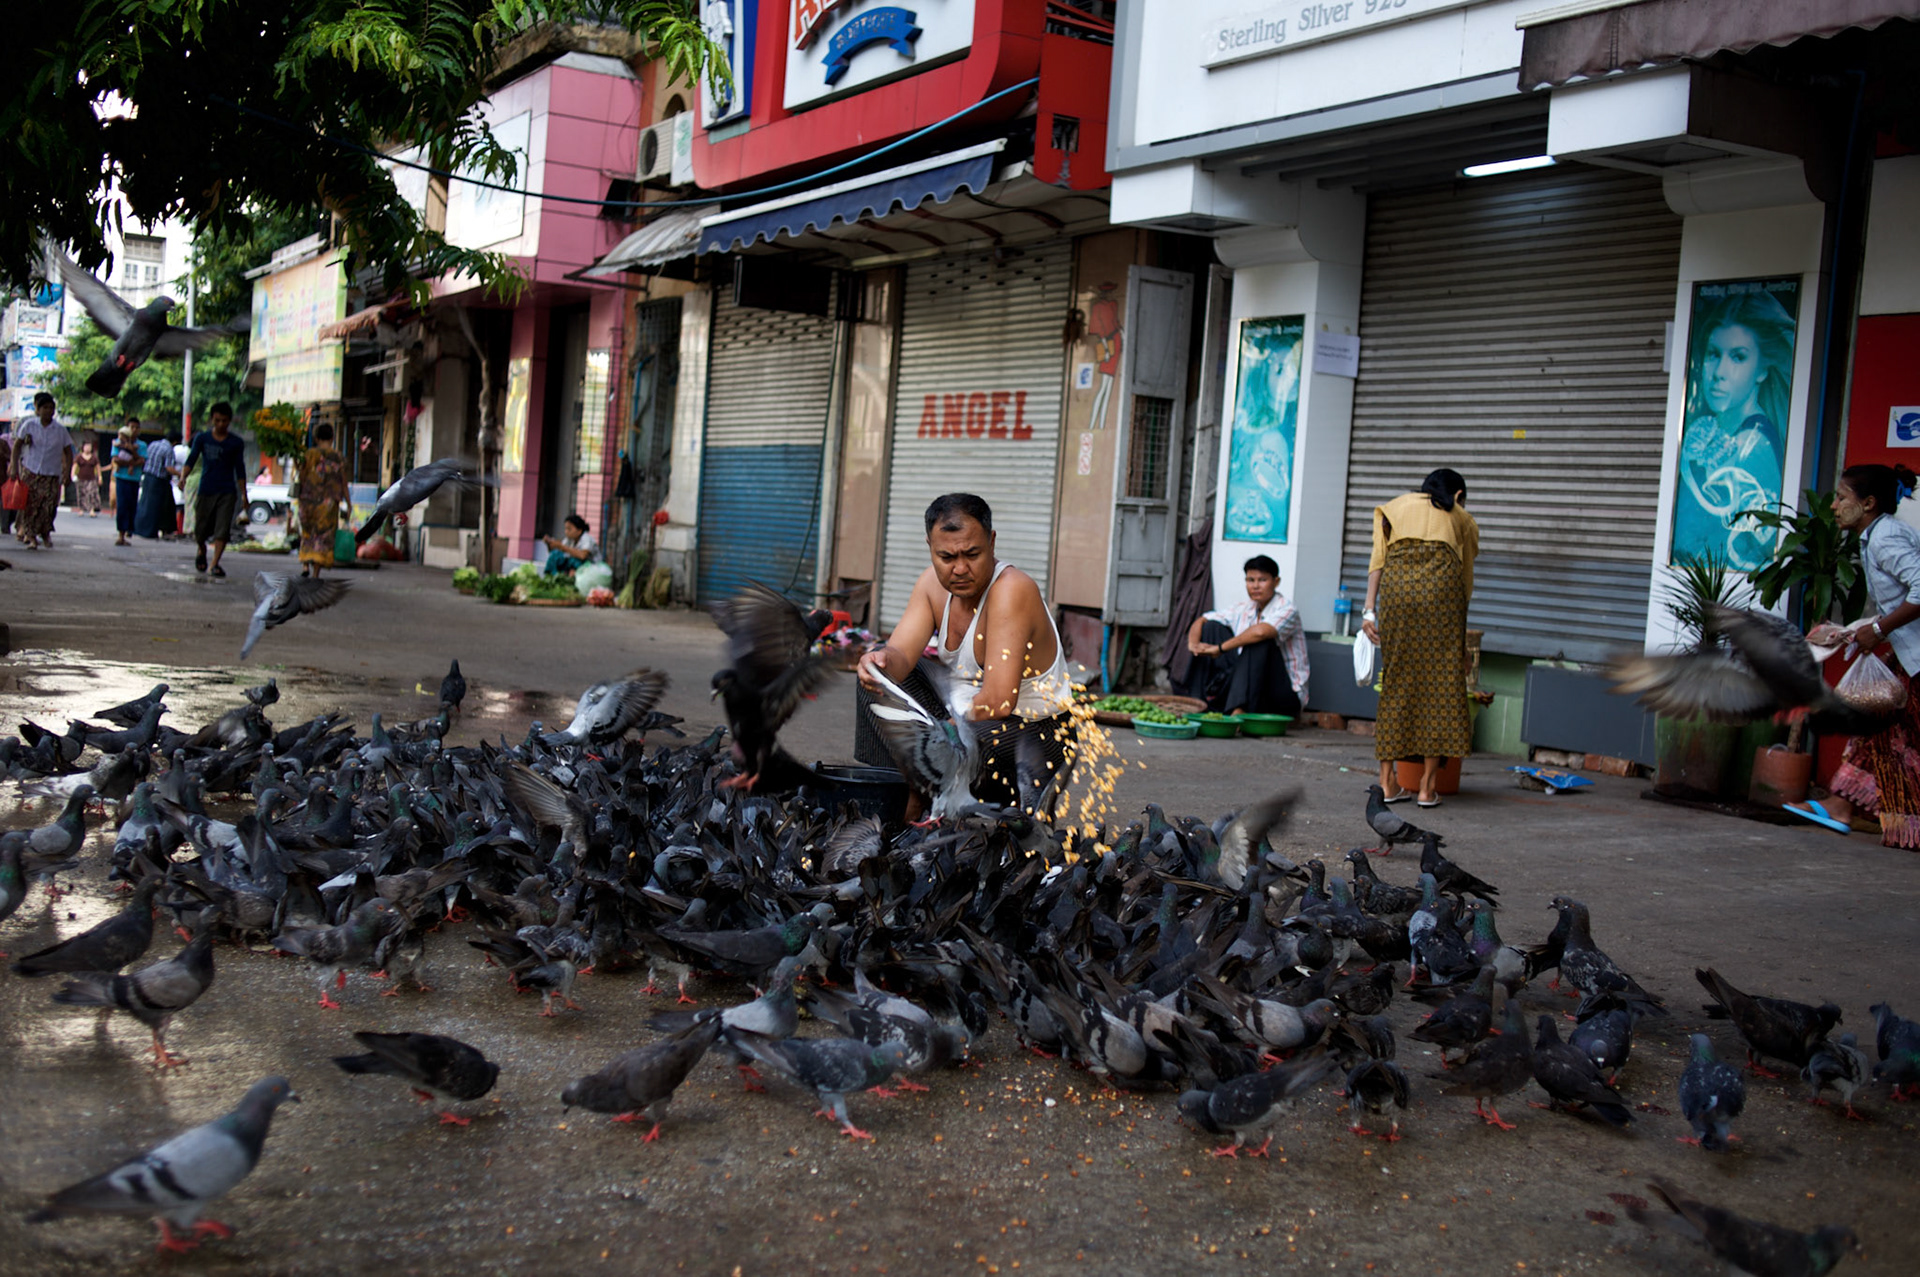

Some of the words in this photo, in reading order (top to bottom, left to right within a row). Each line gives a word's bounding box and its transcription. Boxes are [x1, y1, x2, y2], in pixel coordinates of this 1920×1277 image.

[1218, 18, 1287, 51] Sterling
[1299, 2, 1353, 31] Silver
[917, 390, 1034, 440] ANGEL
